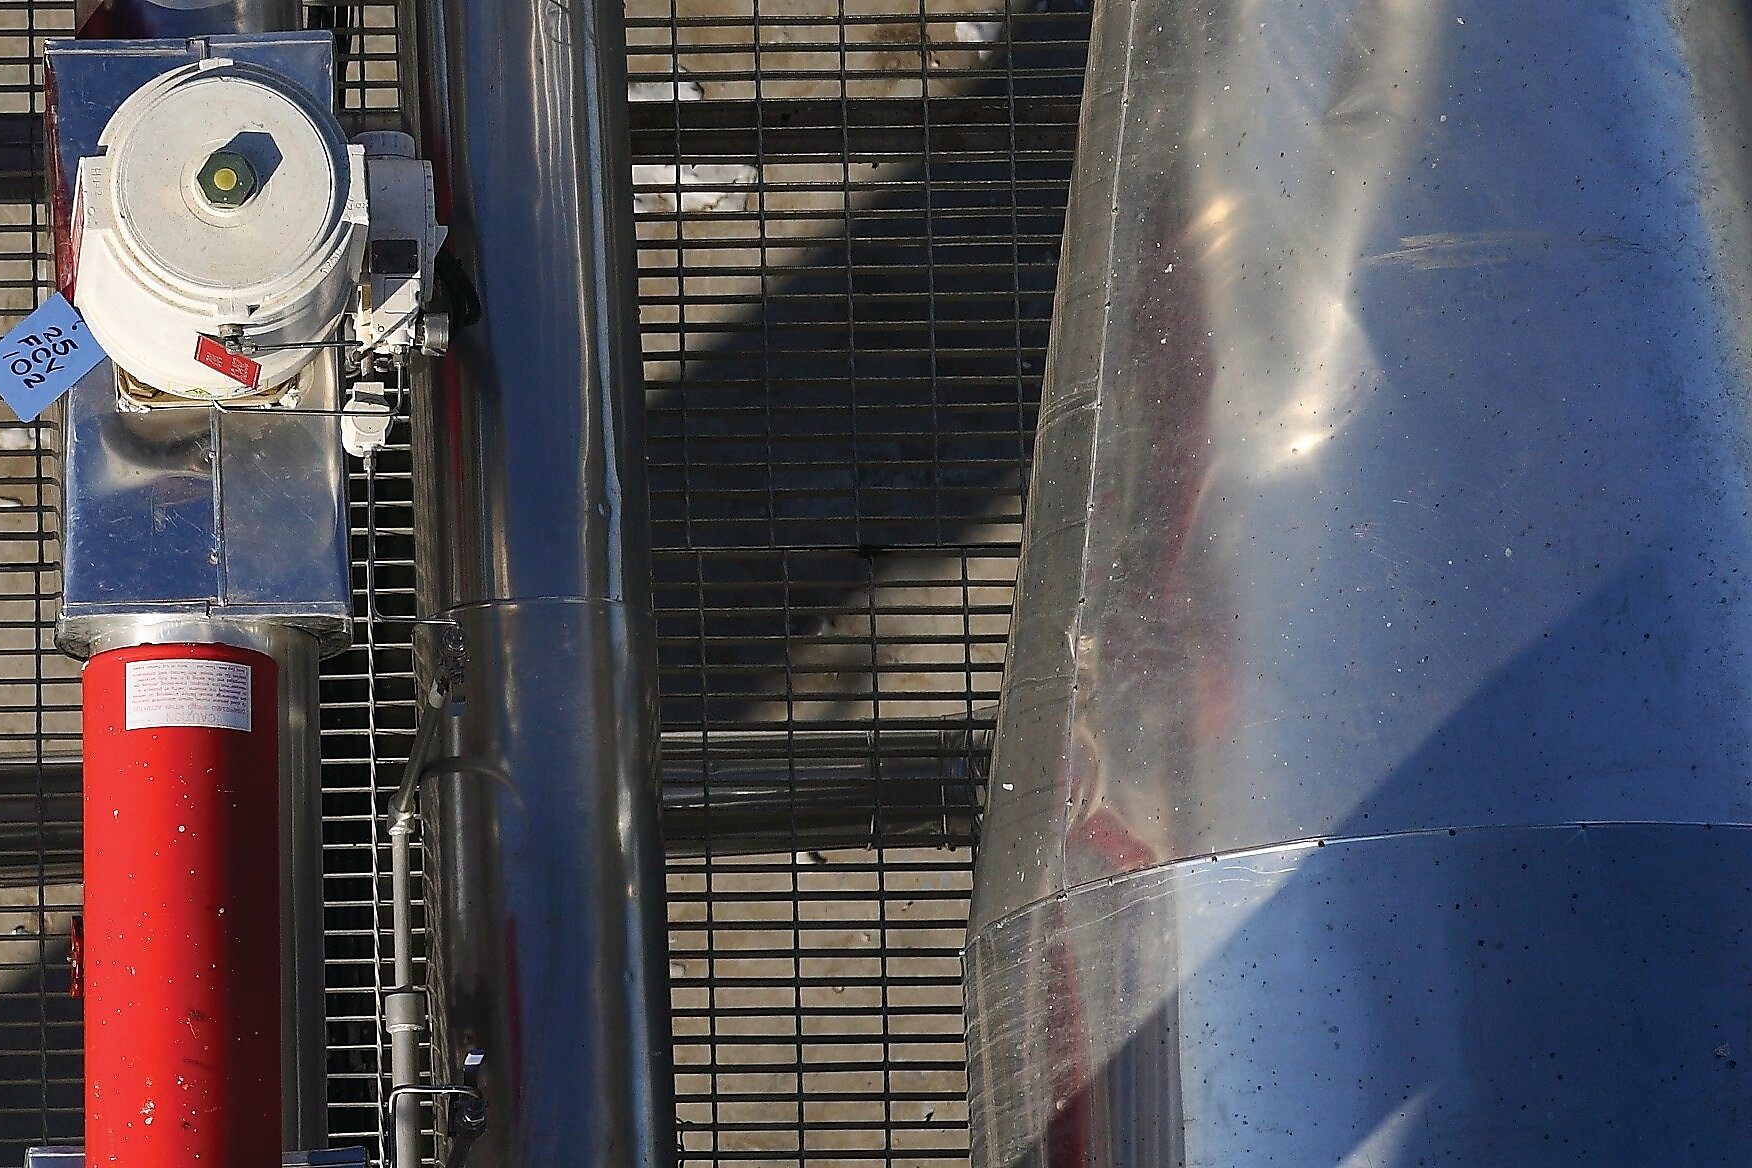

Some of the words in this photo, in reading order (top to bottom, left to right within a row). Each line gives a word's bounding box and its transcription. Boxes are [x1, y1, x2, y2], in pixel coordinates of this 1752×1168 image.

[17, 335, 64, 373] FCV
[43, 327, 78, 355] 25
[3, 351, 45, 388] 102
